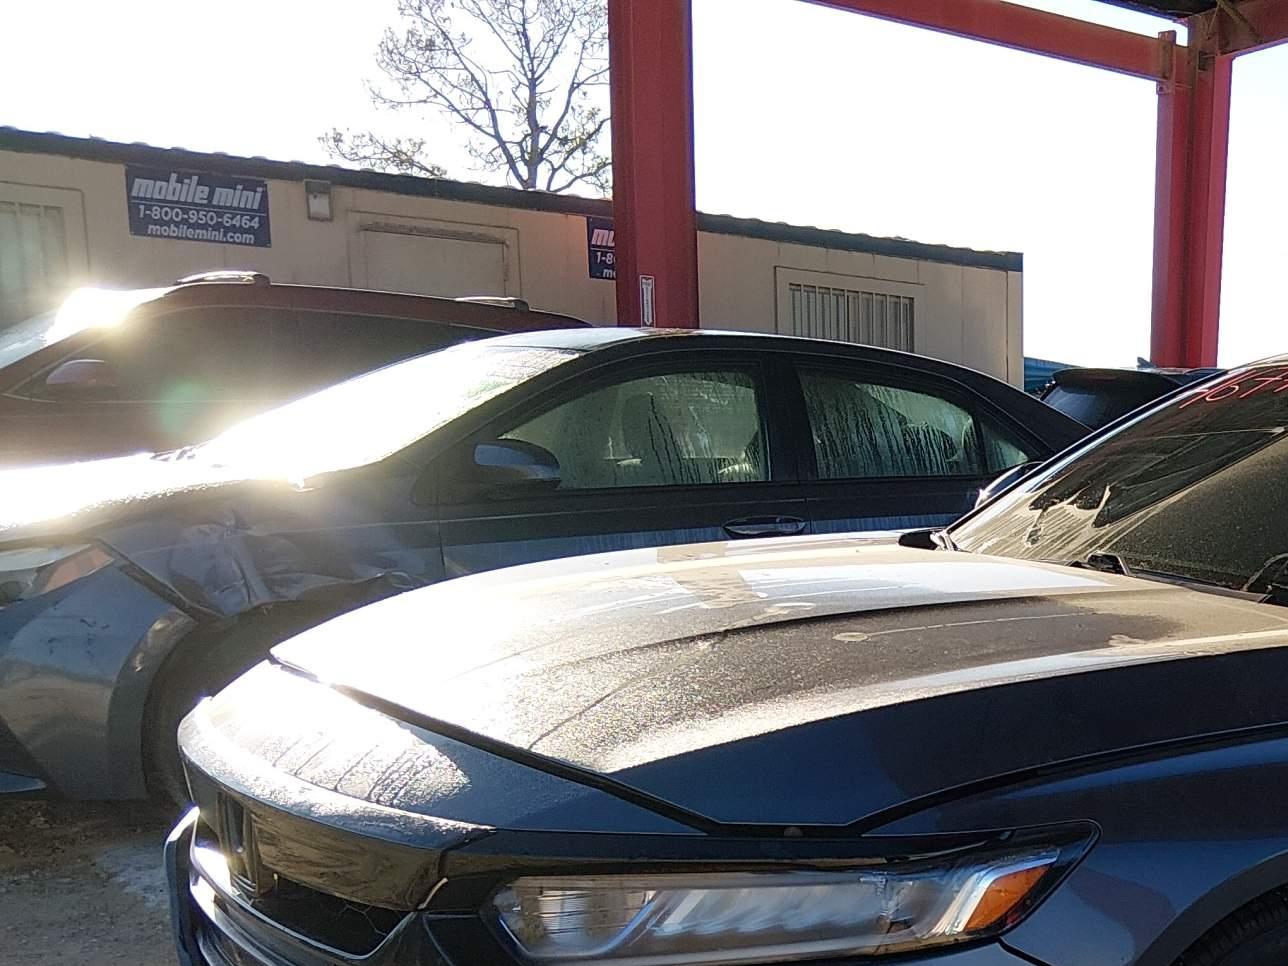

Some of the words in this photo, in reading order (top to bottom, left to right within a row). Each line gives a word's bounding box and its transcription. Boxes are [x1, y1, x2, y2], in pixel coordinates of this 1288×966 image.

[131, 172, 210, 204] mobile
[212, 184, 263, 210] mini
[138, 204, 260, 229] 1-800-950-6464
[147, 223, 255, 244] mobilemini.com
